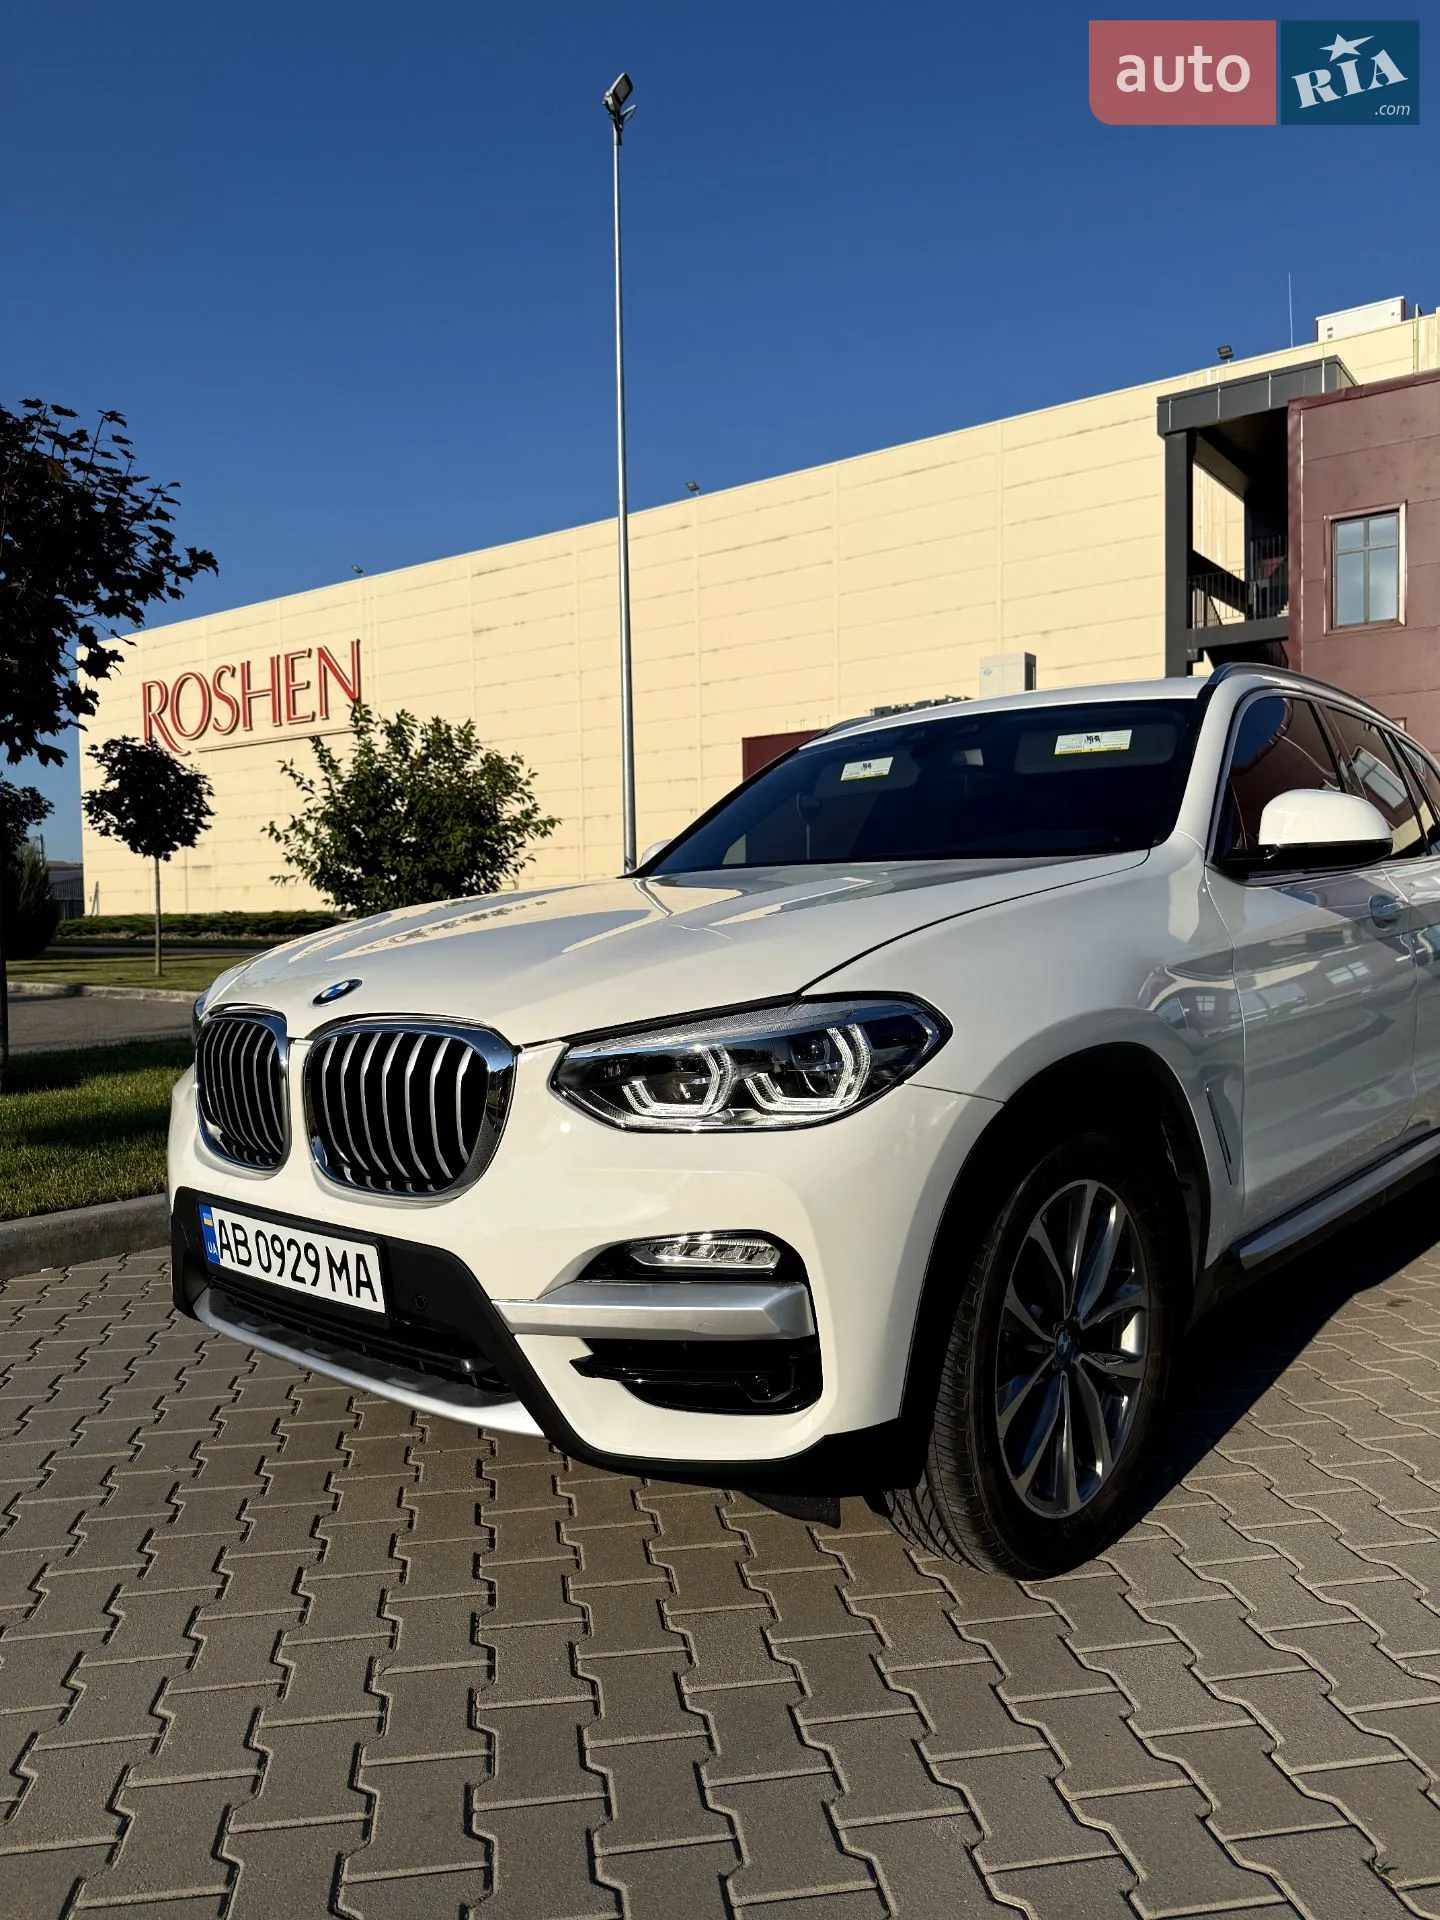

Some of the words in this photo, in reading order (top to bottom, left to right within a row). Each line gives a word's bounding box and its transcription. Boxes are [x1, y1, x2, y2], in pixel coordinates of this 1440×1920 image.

[142, 638, 362, 757] ROSHEN
[207, 1240, 219, 1257] UA
[217, 1218, 253, 1268] AB
[254, 1229, 321, 1287] 0929
[325, 1245, 378, 1303] MA
